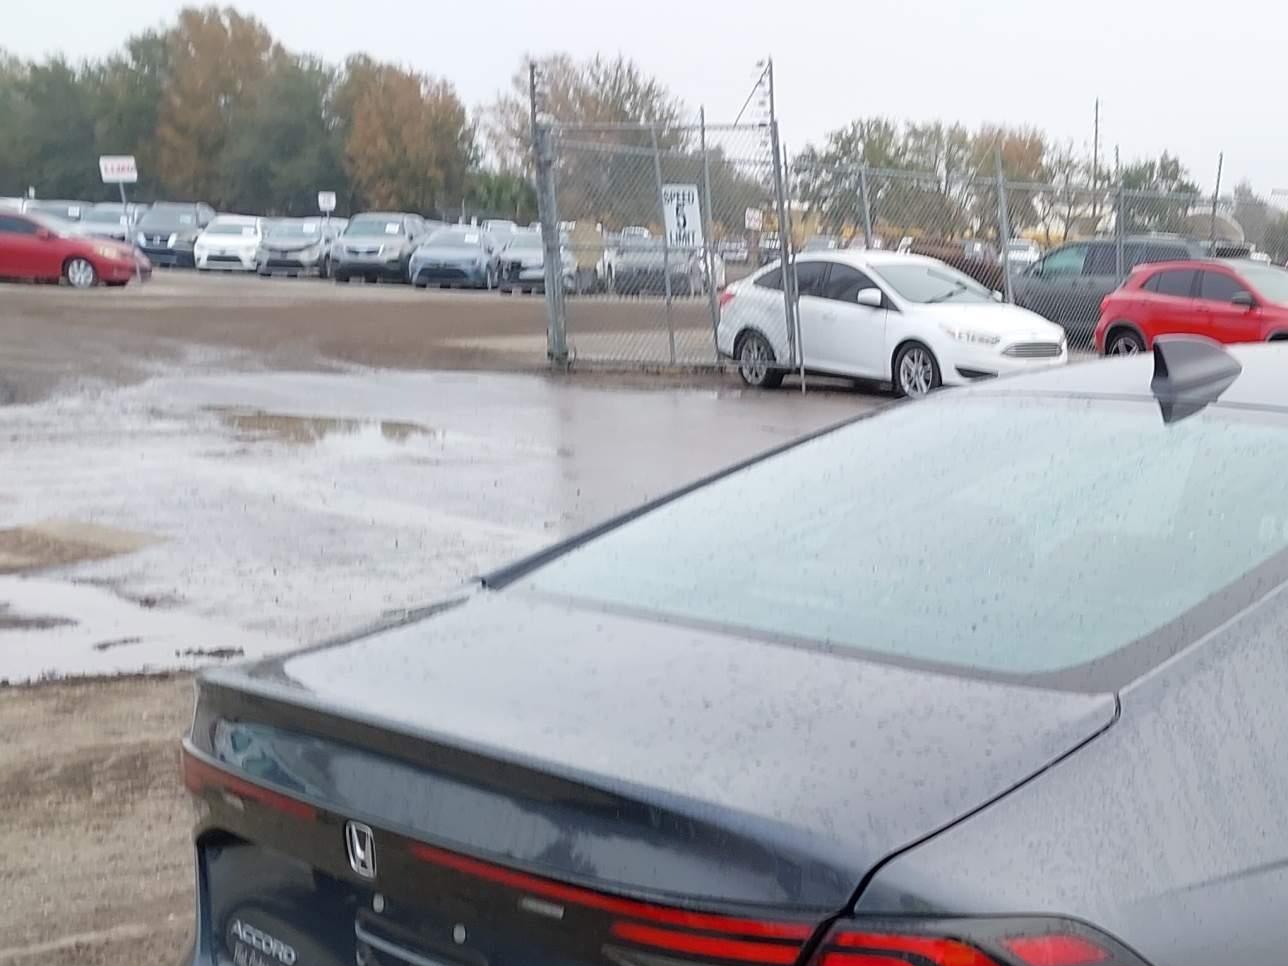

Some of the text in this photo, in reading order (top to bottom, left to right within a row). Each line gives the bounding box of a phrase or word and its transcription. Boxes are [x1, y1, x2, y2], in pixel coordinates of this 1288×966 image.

[663, 190, 695, 204] SPEED
[669, 231, 695, 246] LIMIT
[232, 919, 296, 966] ACCORD
